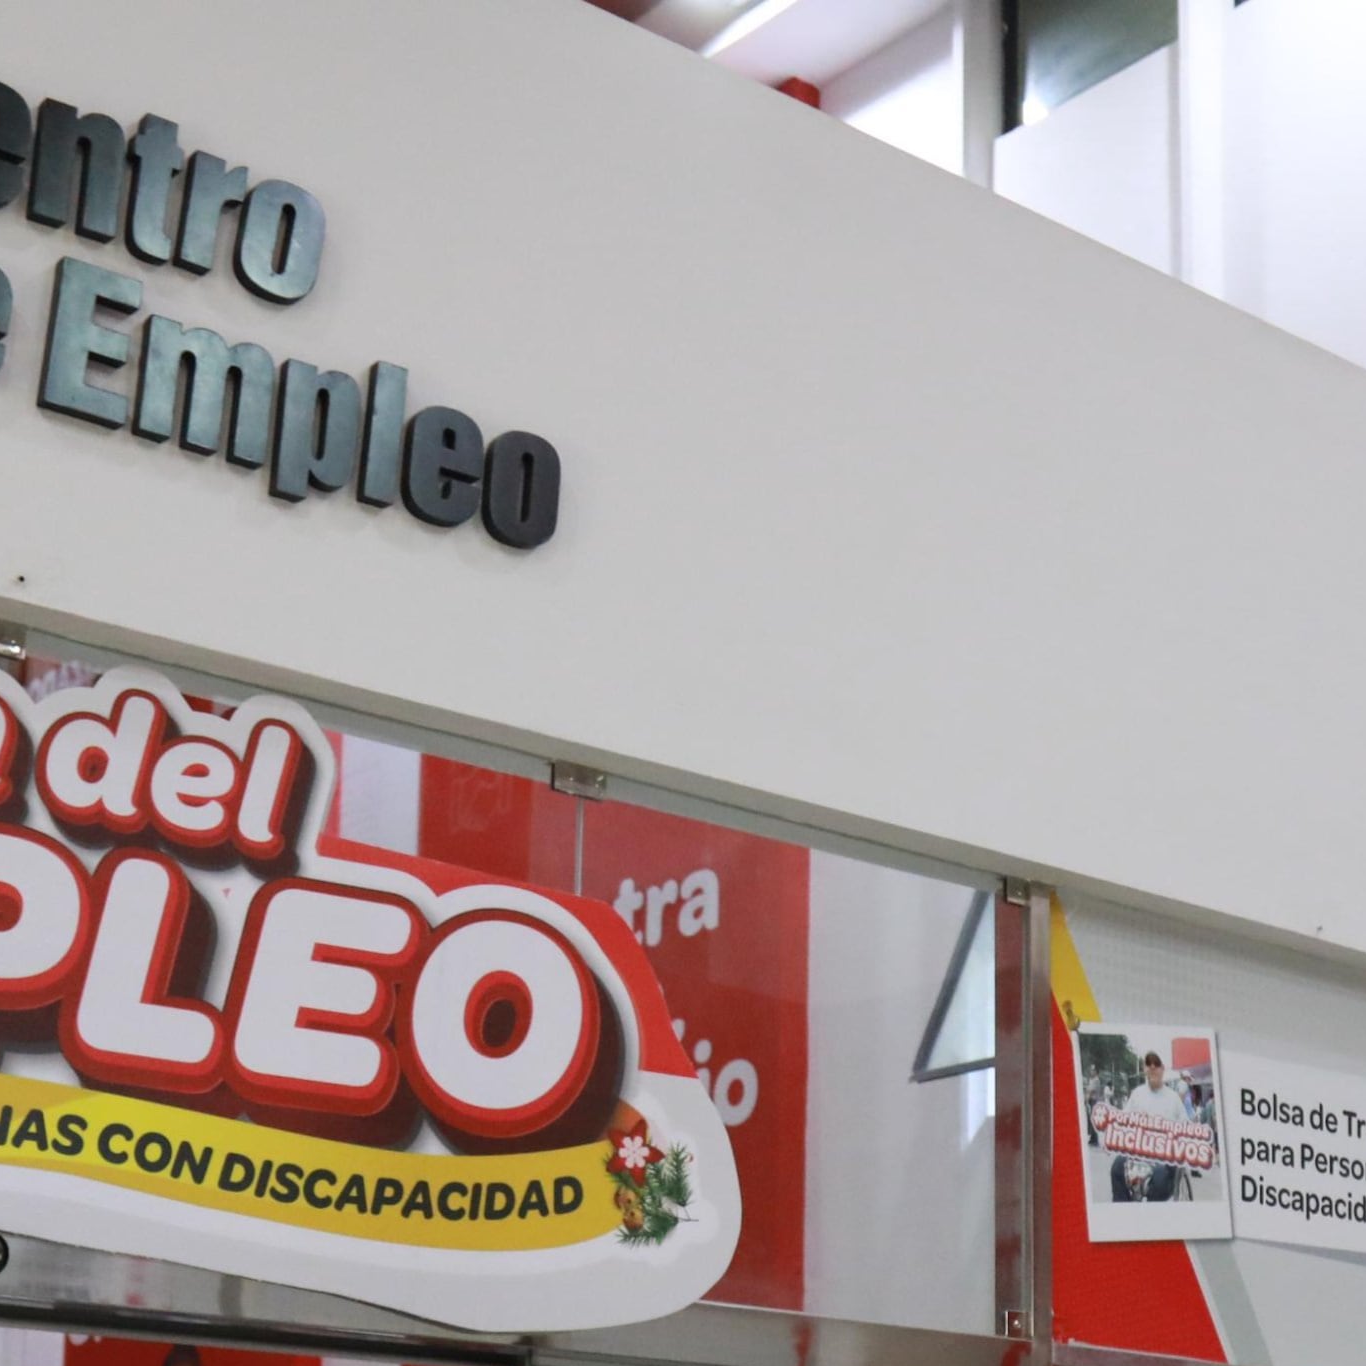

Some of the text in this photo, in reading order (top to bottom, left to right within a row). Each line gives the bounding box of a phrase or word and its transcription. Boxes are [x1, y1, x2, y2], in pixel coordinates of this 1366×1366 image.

[37, 256, 563, 551] Empleo
[41, 690, 297, 846] del
[1104, 1125, 1212, 1163] Inclusivos
[1240, 1088, 1305, 1127] Bolsa
[1309, 1103, 1339, 1133] de
[96, 1122, 214, 1185] CON
[217, 1151, 585, 1222] DISCAPACIDAD
[1241, 1136, 1295, 1168] para
